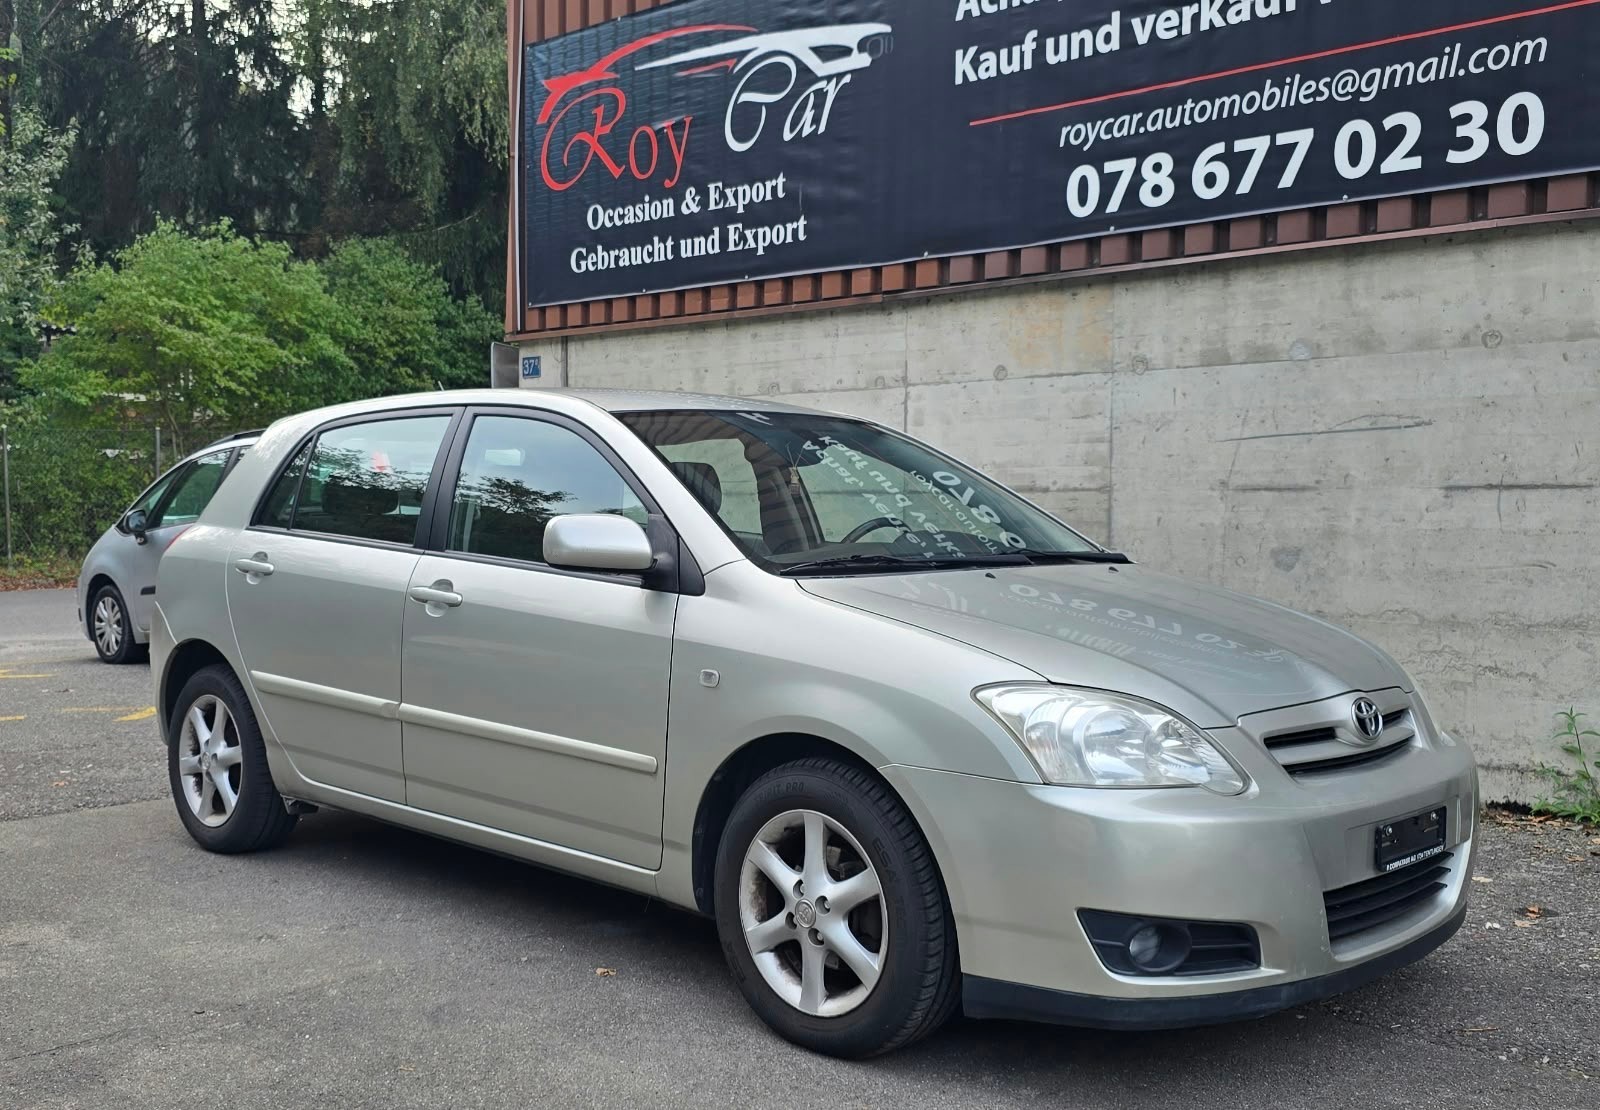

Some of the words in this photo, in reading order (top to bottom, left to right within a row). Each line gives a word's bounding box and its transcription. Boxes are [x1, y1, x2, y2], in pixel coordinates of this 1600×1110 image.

[955, 29, 1038, 85] Kauf
[1046, 10, 1120, 65] und
[1131, 0, 1296, 46] verkau
[540, 87, 694, 191] Roy
[724, 55, 852, 152] Car
[1059, 37, 1548, 151] roycar.automobiles@gmail.com
[586, 194, 675, 231] Occasion
[680, 186, 701, 215] &
[707, 172, 786, 213] Export
[1066, 151, 1175, 218] 078
[1191, 128, 1314, 200] 677
[1333, 111, 1422, 180] 02
[1446, 91, 1545, 164] 30
[570, 235, 674, 273] Gebraucht
[680, 226, 720, 258] und
[727, 214, 808, 255] Export
